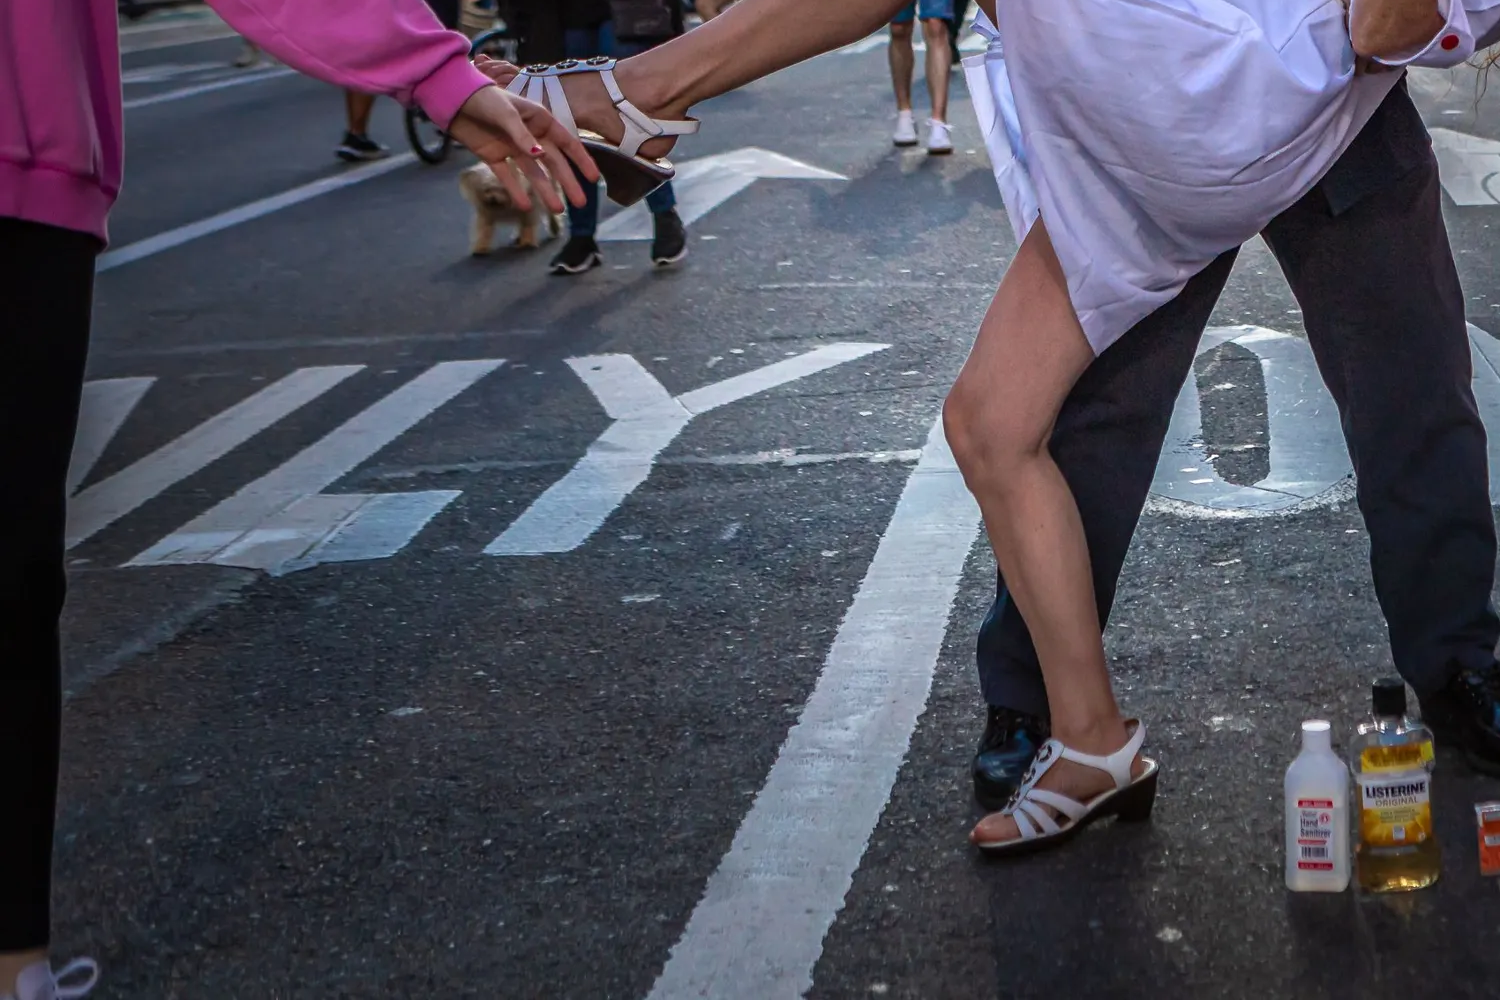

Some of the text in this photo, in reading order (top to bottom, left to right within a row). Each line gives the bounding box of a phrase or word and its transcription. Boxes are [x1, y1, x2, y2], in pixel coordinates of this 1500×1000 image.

[1365, 780, 1427, 799] LISTERINE
[1374, 796, 1419, 808] ORIGINAL
[1299, 817, 1319, 829] Hand
[1299, 828, 1332, 839] Sanitizer
